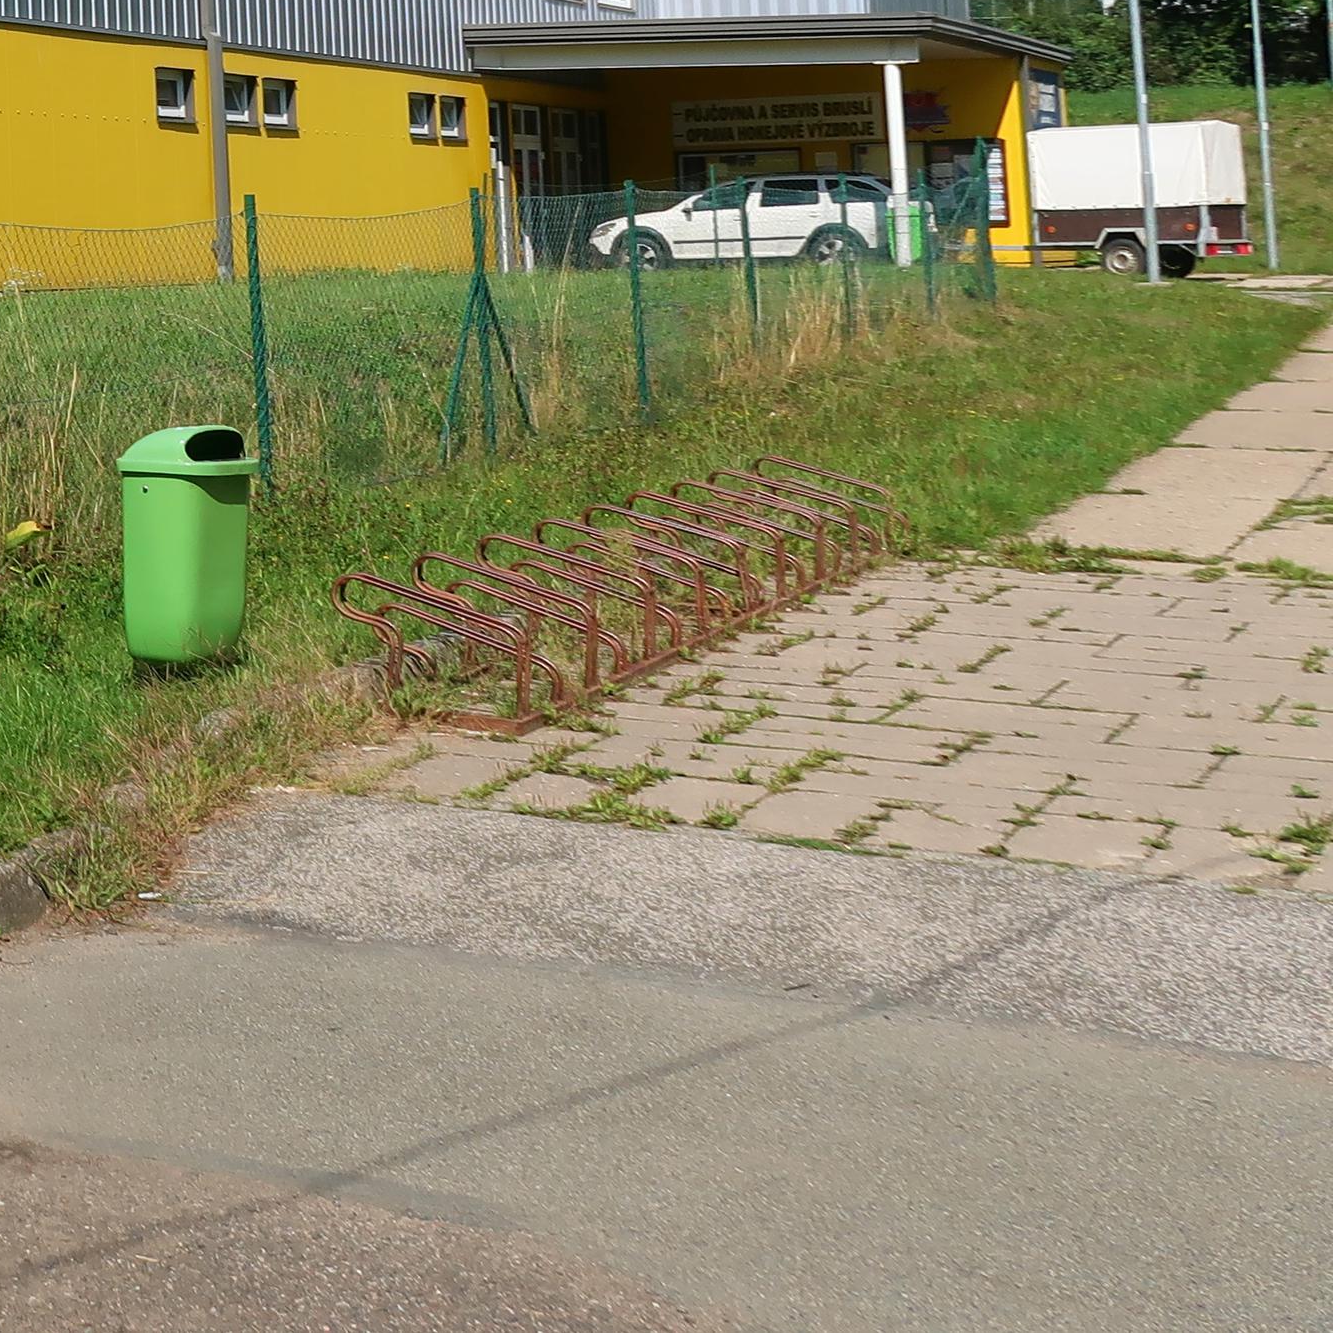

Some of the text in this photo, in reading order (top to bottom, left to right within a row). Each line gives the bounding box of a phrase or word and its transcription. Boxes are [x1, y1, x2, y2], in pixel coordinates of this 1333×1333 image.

[758, 105, 769, 120] A
[771, 102, 820, 119] SERVIS
[822, 97, 874, 117] BRUSLÍ
[685, 126, 734, 143] OPRAVA
[737, 120, 805, 141] HOKEJOVÉ
